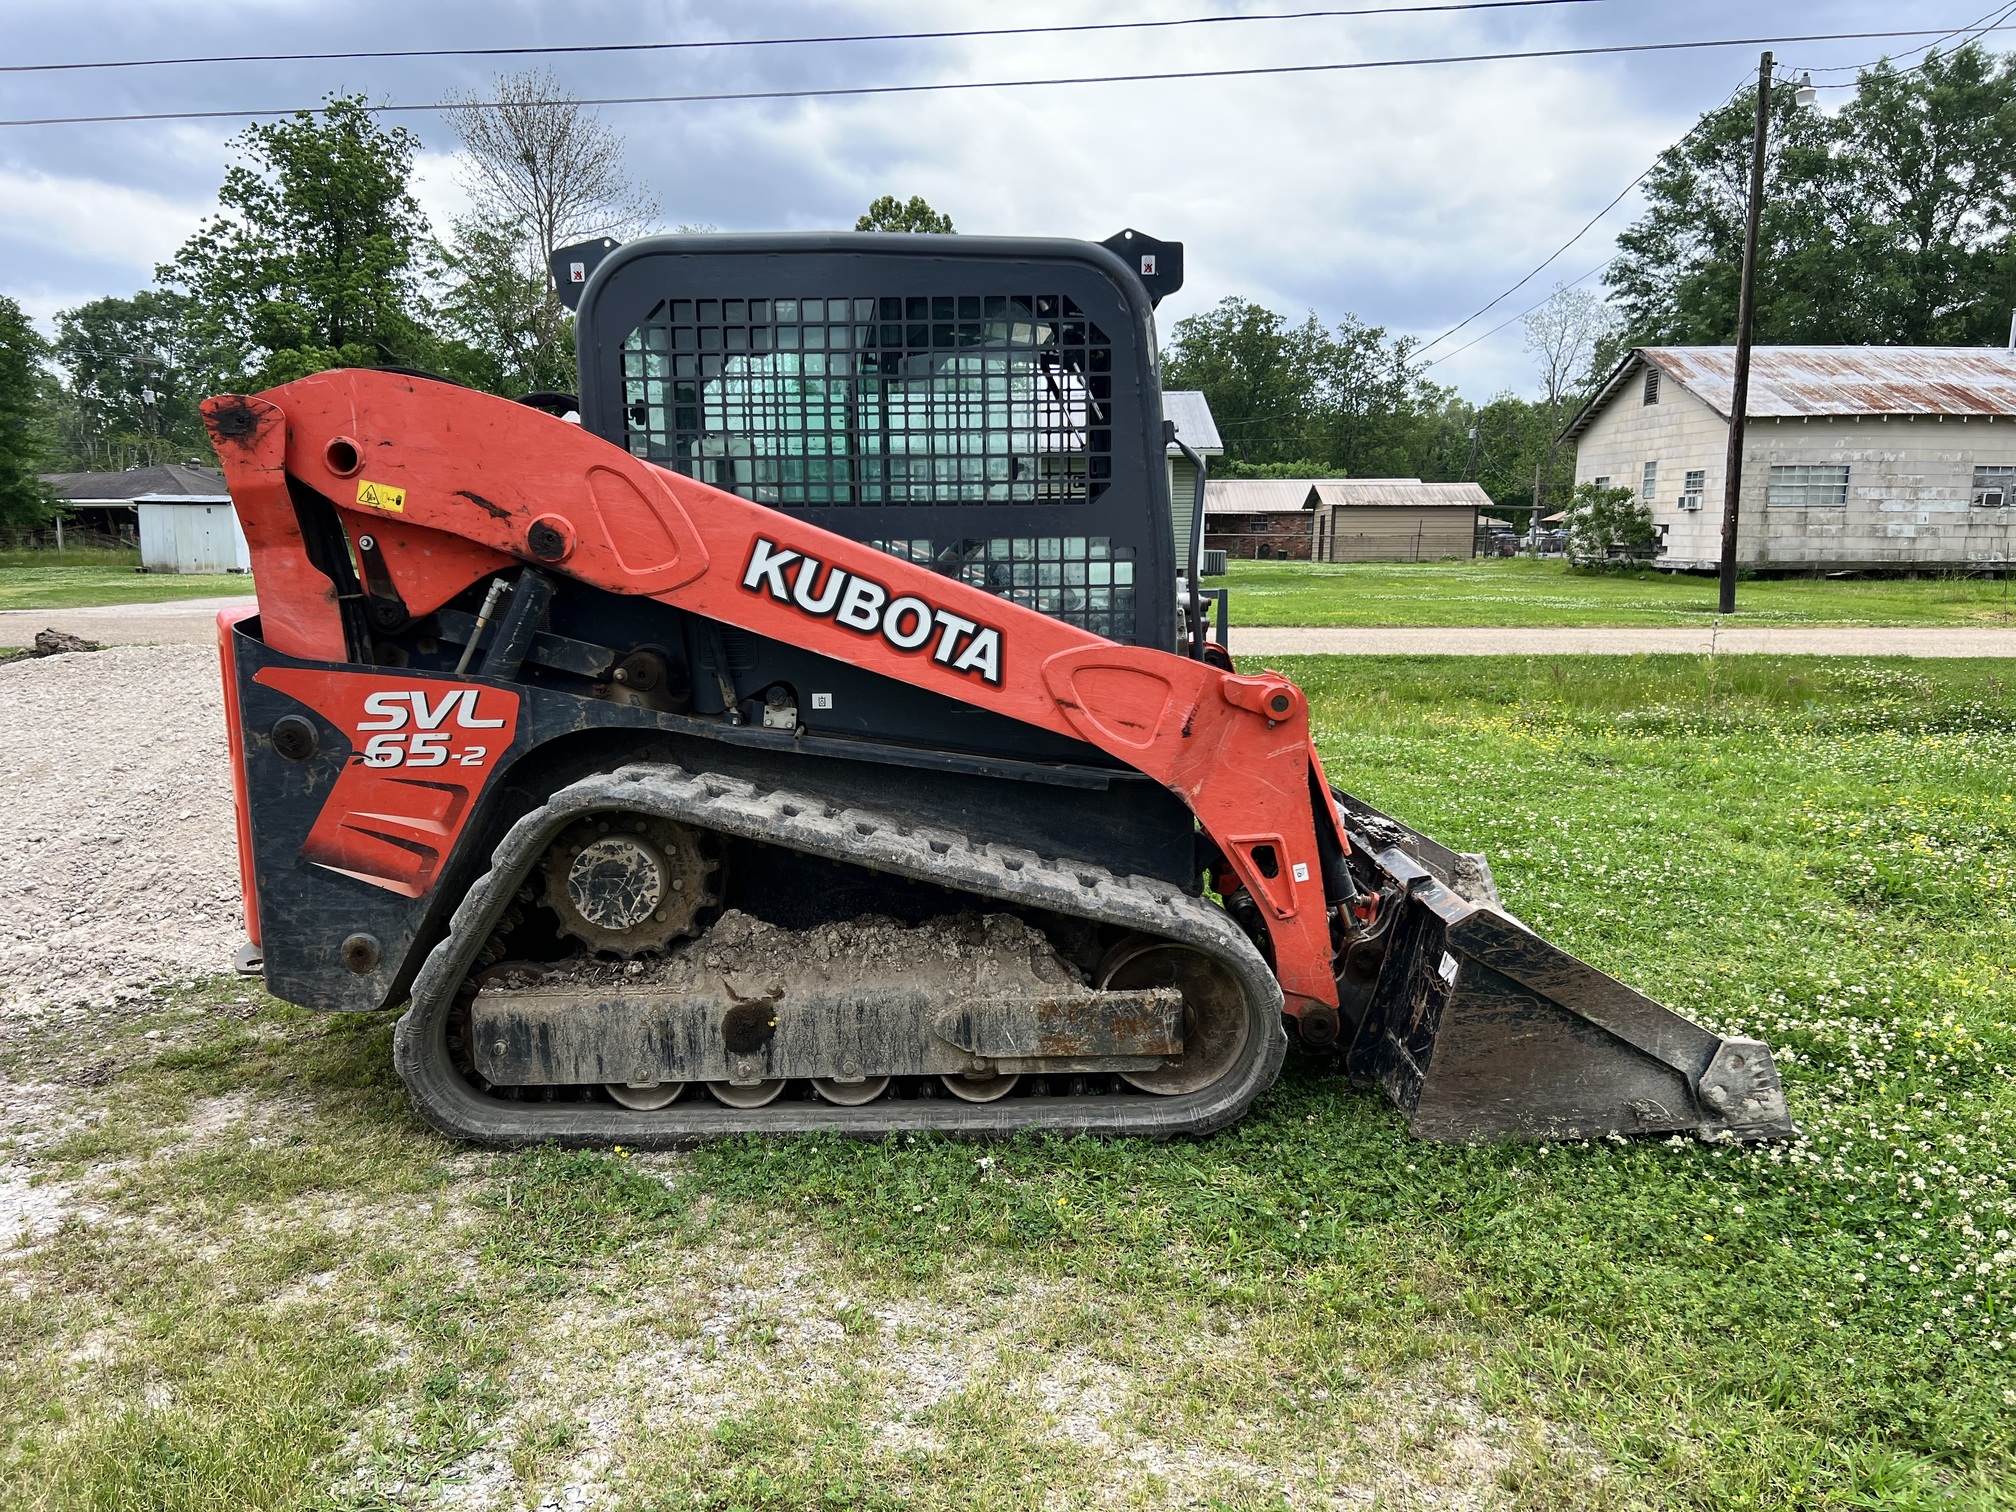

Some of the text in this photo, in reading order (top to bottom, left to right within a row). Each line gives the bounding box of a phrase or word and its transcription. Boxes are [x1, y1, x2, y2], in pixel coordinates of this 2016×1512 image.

[743, 538, 999, 683] KUBOTA
[356, 690, 506, 731] SVL
[364, 733, 487, 768] 65-2
